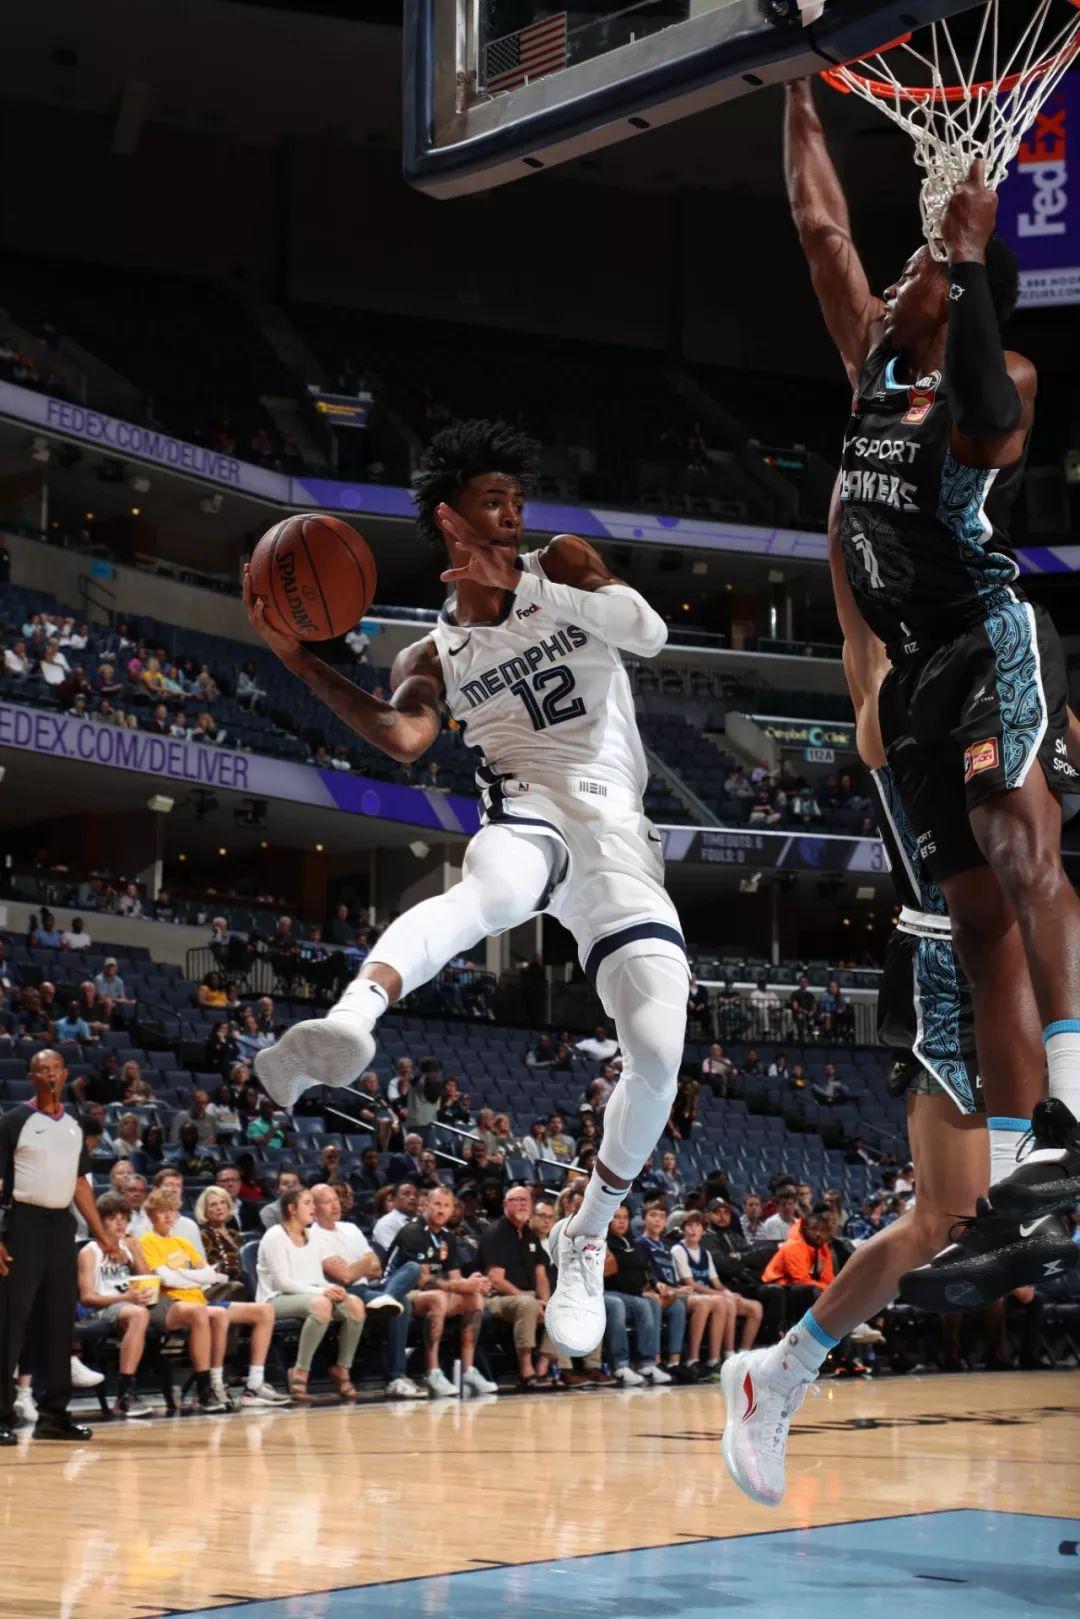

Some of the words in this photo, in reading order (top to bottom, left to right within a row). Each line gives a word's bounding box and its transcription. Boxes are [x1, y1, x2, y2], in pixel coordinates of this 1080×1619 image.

[1017, 109, 1067, 237] FedEx
[47, 397, 241, 485] FEDEX.COM/DELIVER
[855, 437, 921, 464] SPORT
[277, 550, 319, 632] SPALDING
[459, 625, 588, 708] MEMPHIS
[510, 664, 587, 731] 12
[808, 749, 834, 762] 112A
